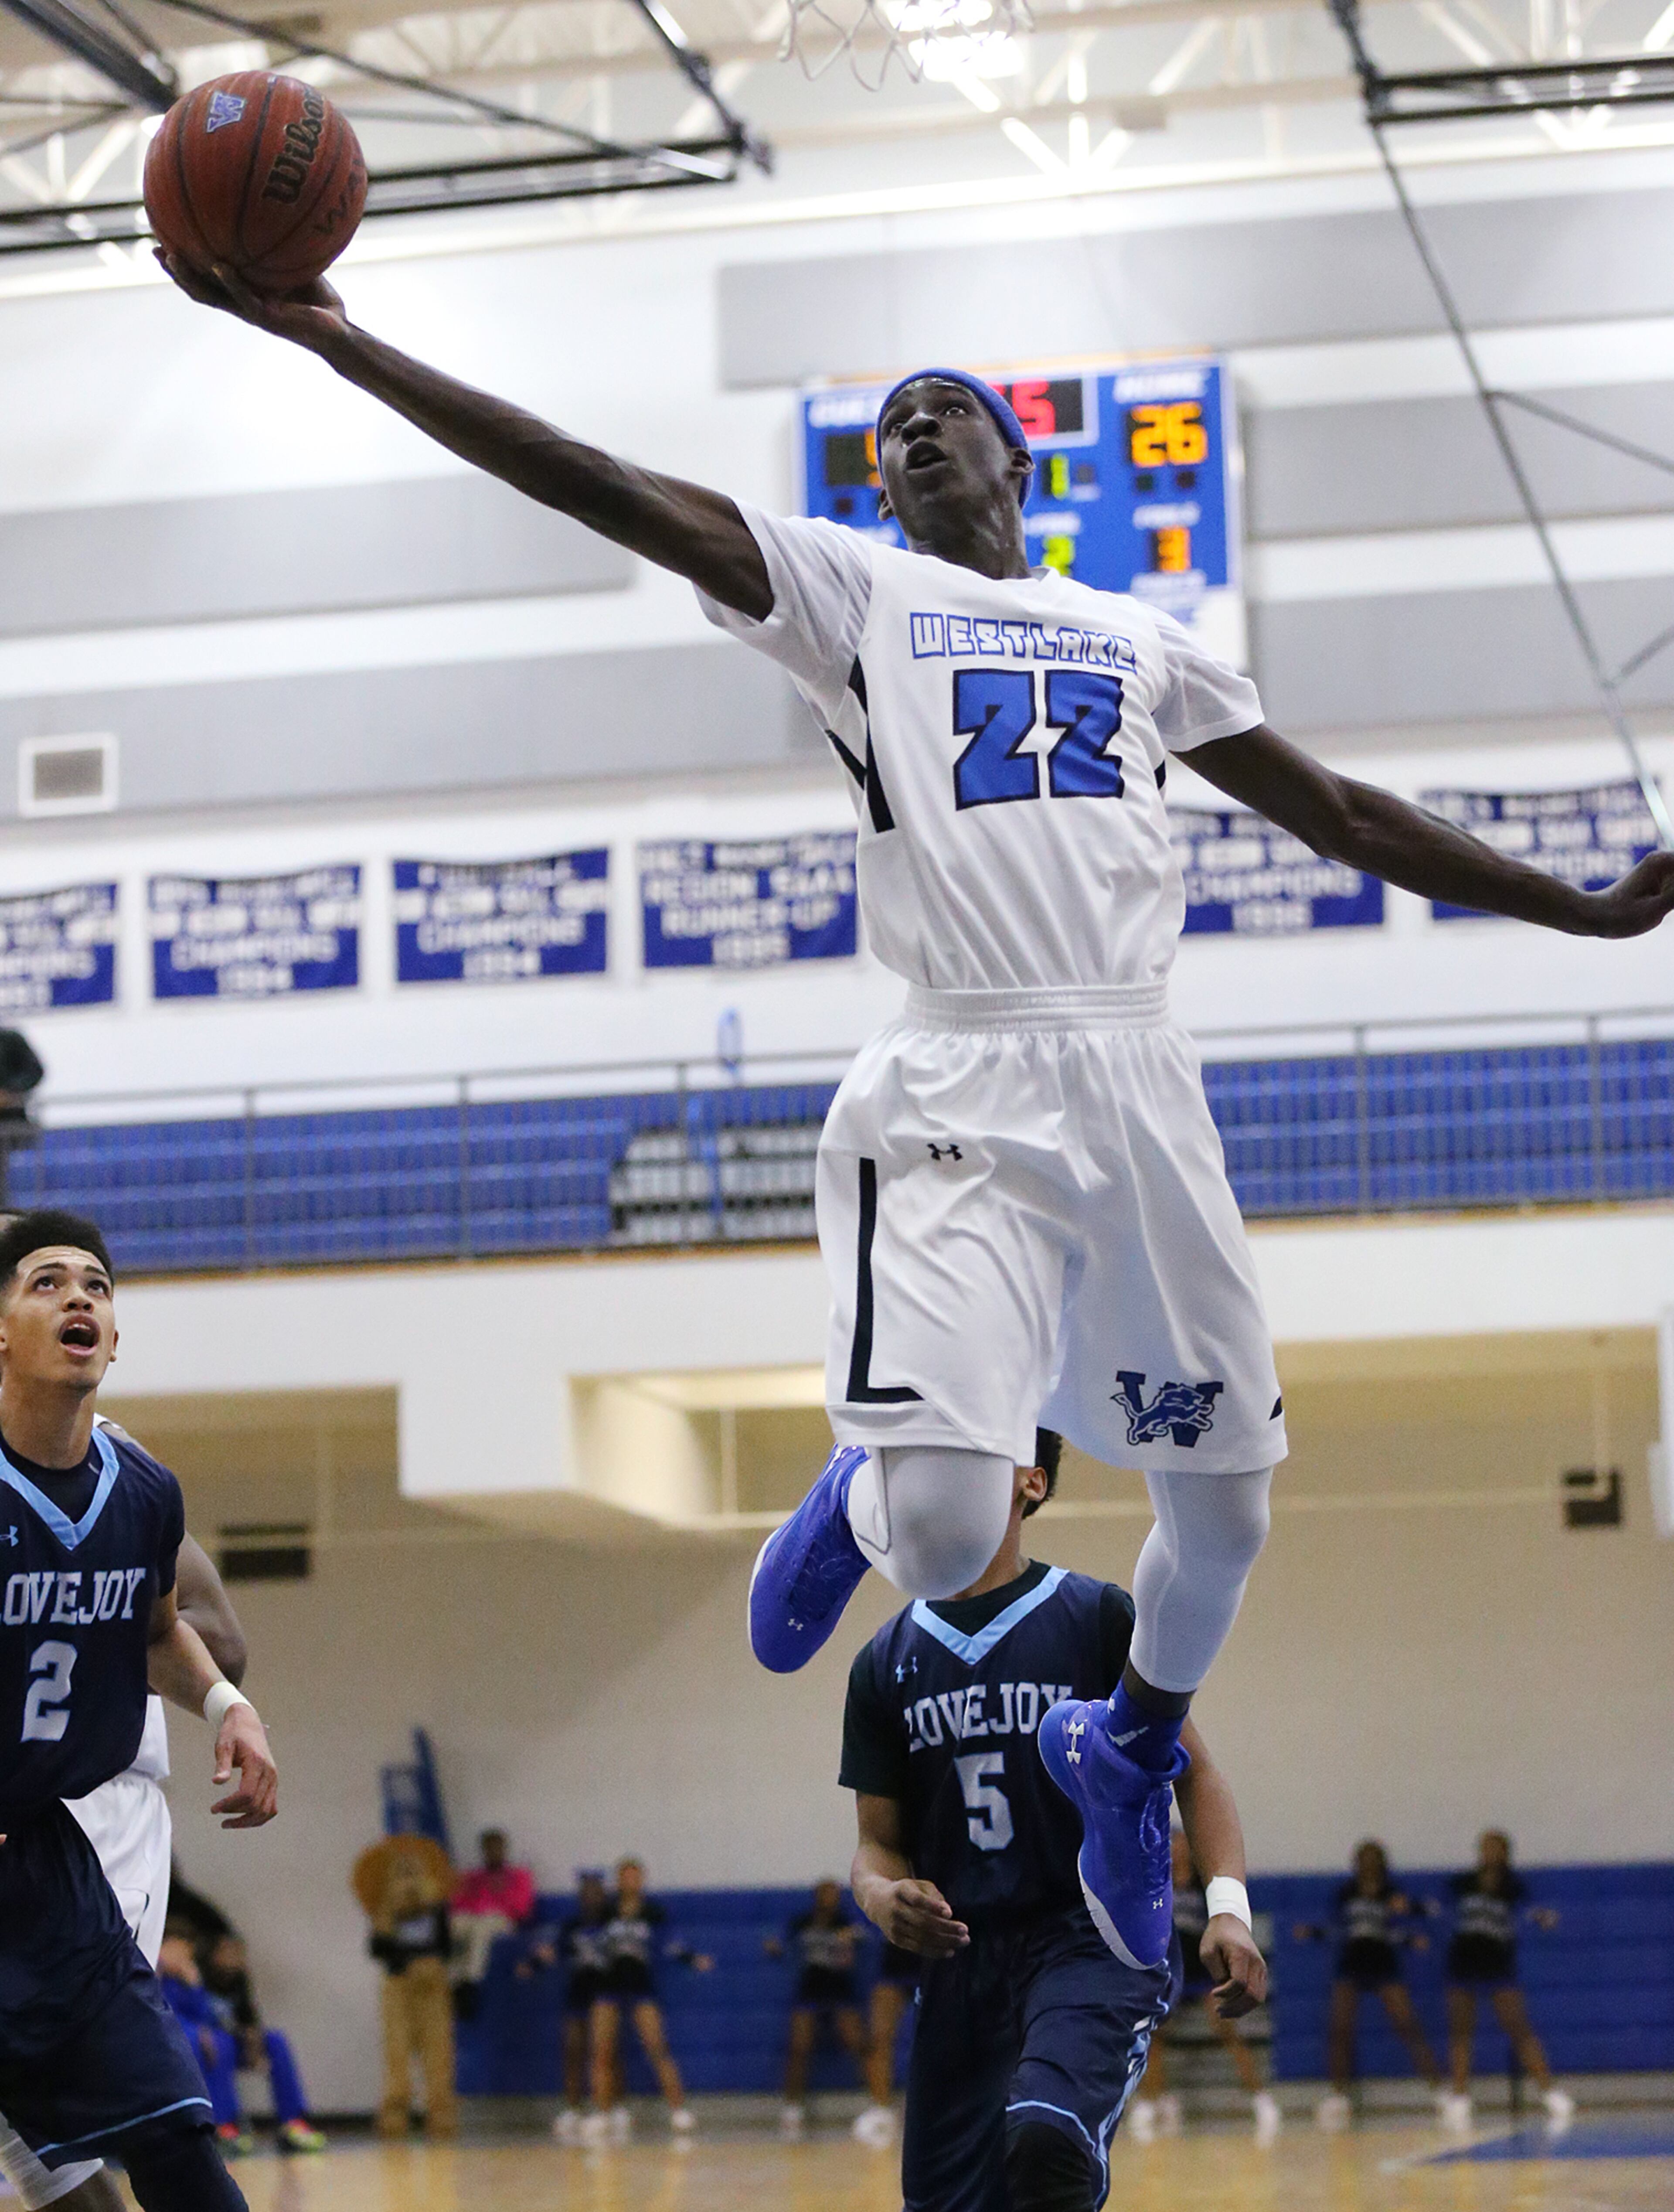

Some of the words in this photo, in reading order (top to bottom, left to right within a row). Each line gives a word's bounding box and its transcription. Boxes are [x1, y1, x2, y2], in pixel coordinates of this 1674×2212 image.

[1131, 400, 1208, 468] 26
[910, 612, 1138, 675] WESTLAKE
[953, 668, 1125, 812] 22
[0, 1567, 146, 1626] OVEJOY
[20, 1639, 78, 1742] 2
[955, 1751, 1014, 1851] 5
